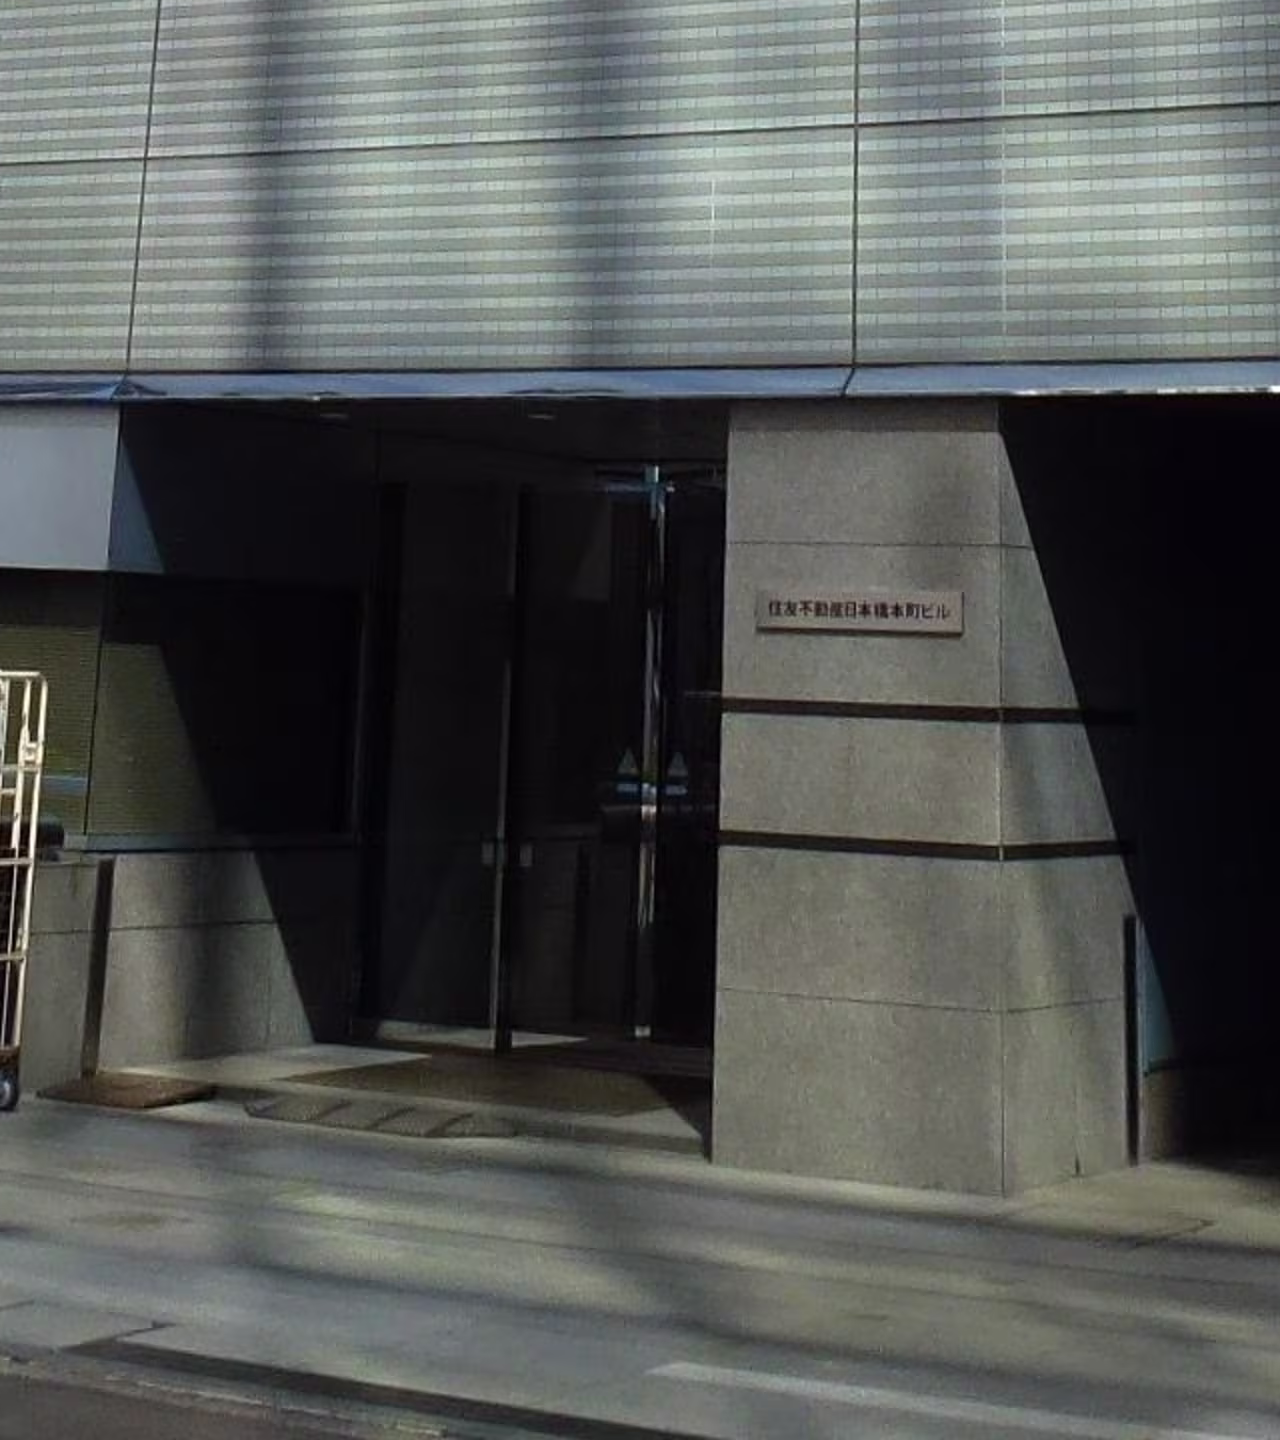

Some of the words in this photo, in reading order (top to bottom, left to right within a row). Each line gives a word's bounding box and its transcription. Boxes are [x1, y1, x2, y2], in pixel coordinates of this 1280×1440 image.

[769, 599, 950, 620] 住友不動産日本橋本町ビル
